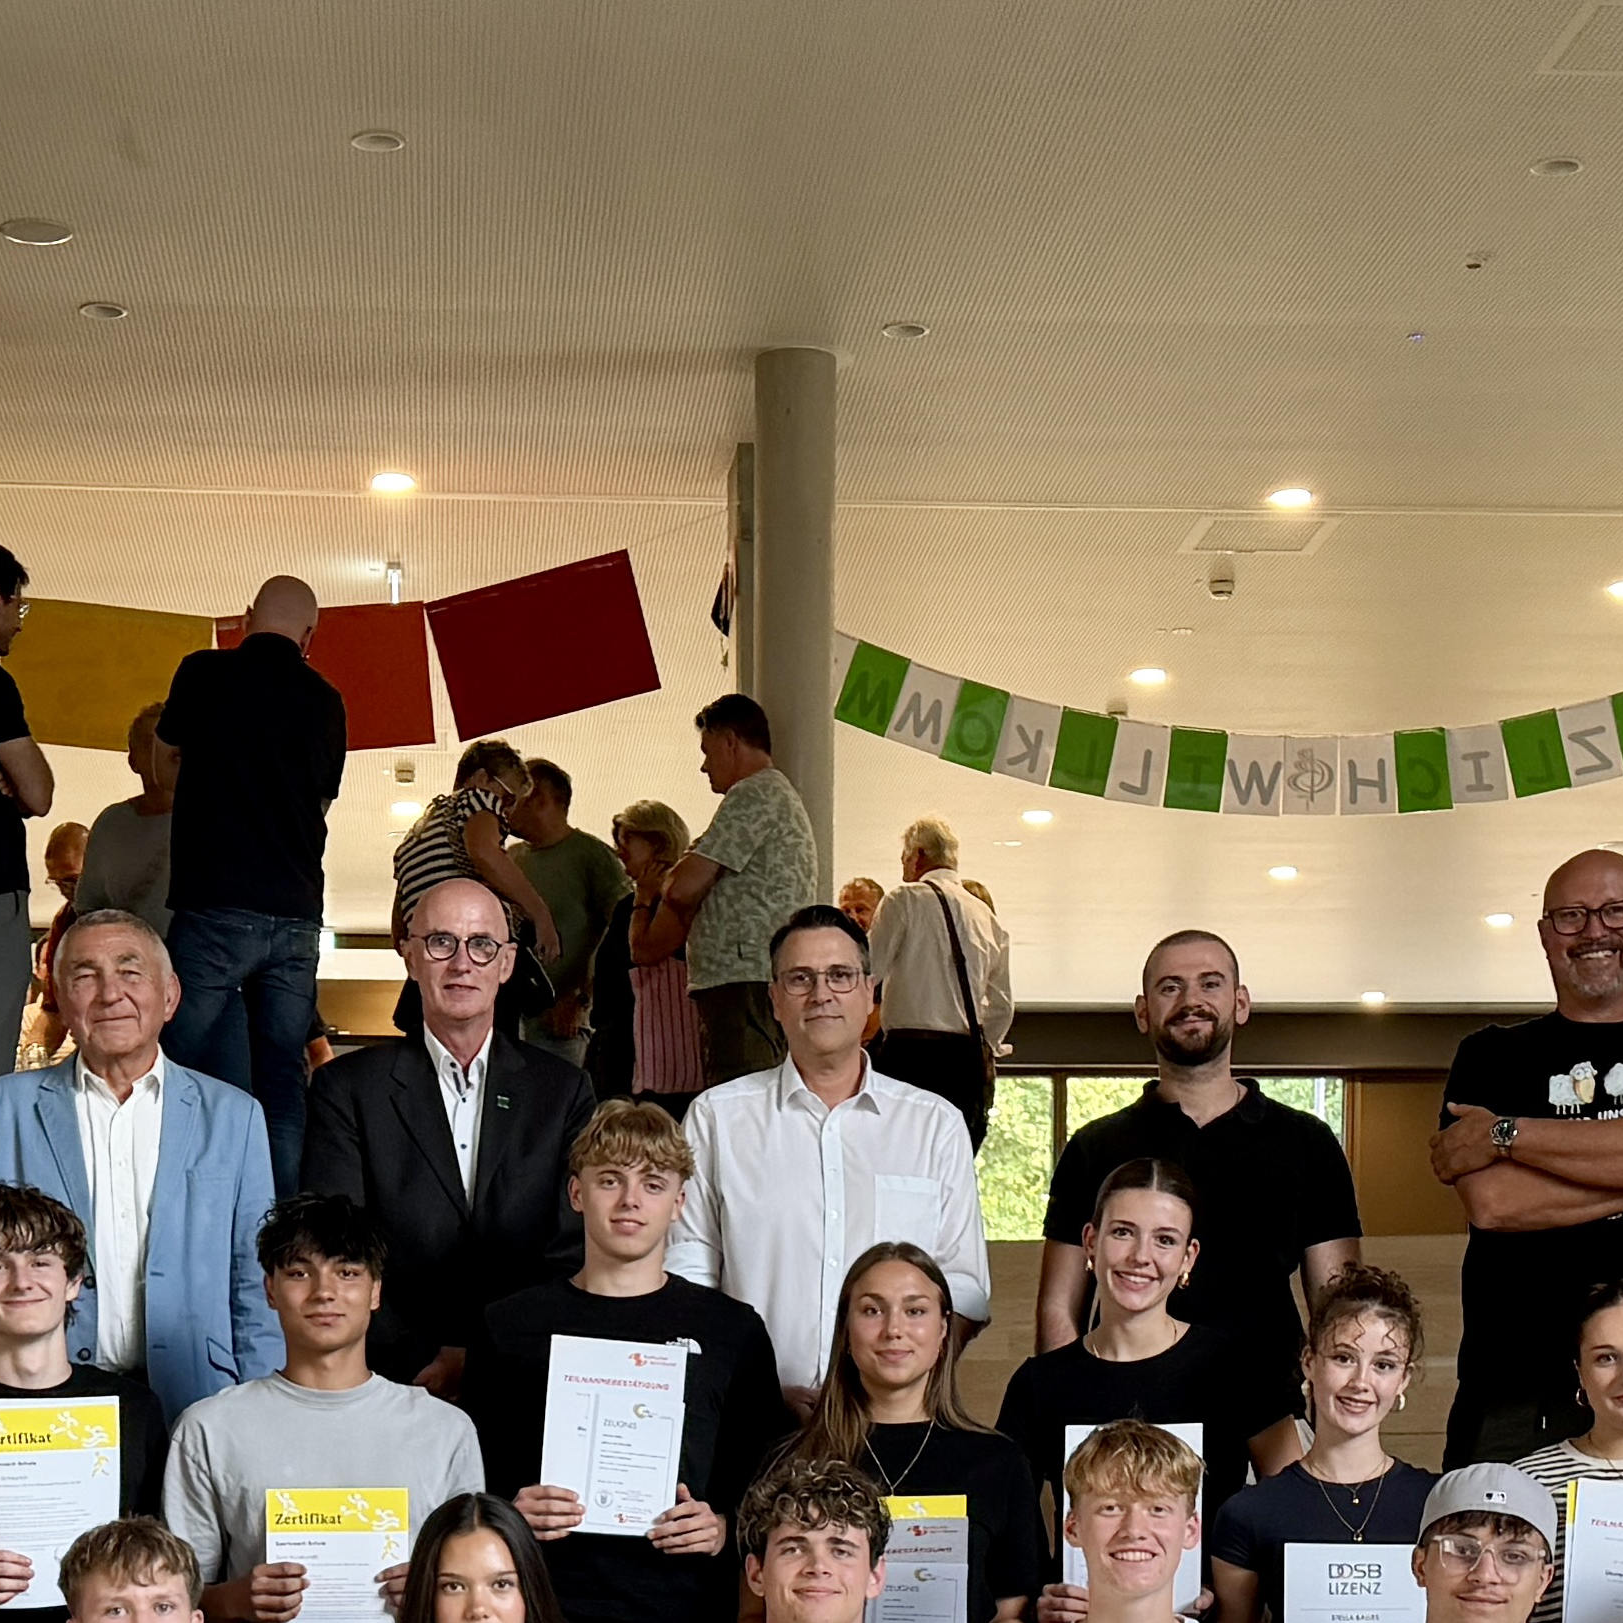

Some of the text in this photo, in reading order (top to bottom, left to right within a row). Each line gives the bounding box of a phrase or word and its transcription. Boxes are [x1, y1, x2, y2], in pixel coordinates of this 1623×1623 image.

[275, 1513, 342, 1526] Zertifikat
[1328, 1563, 1383, 1579] DOSB
[1328, 1582, 1383, 1596] LIZENZ
